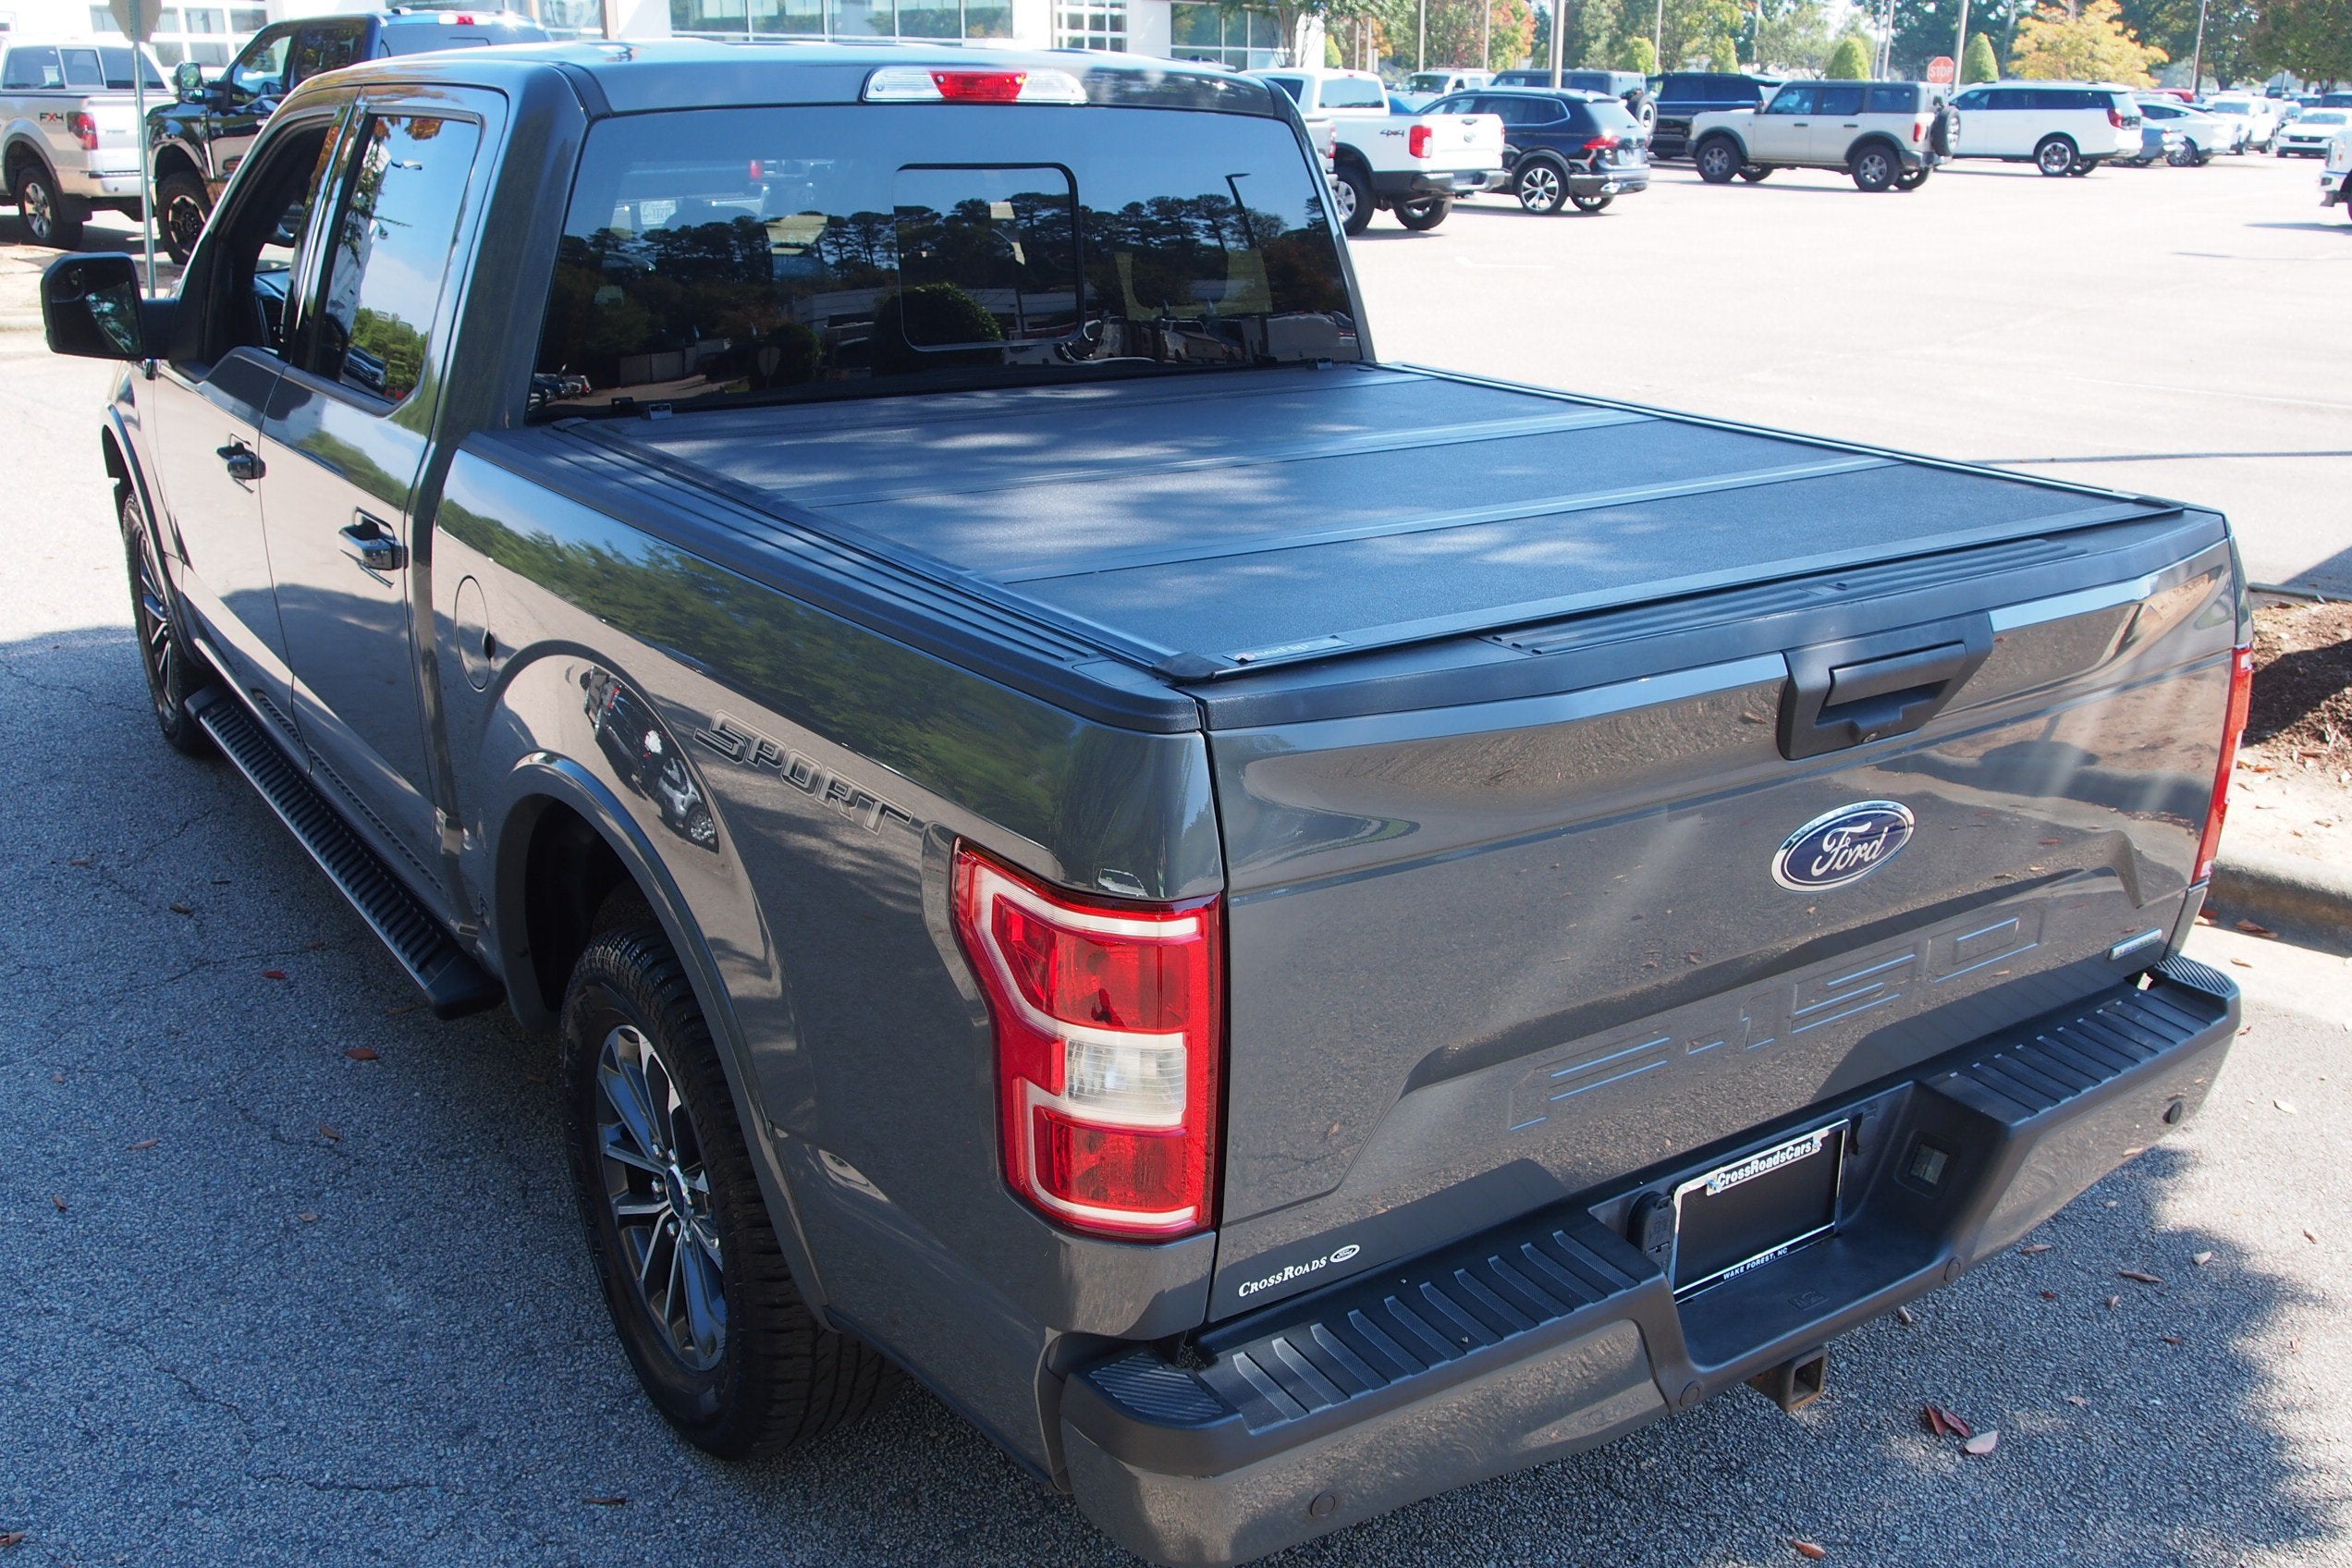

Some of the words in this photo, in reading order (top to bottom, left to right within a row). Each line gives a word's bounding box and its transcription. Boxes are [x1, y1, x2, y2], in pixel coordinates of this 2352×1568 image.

[1929, 66, 1954, 78] STOP
[40, 112, 64, 121] FX4
[693, 709, 914, 836] SPORT
[1810, 821, 1890, 877] Ford
[1508, 900, 2045, 1132] F-150
[1717, 1140, 1812, 1188] CrossRoadsCars
[1722, 1266, 1745, 1280] WAKE
[1746, 1253, 1776, 1270] FOREST,
[1777, 1247, 1788, 1256] NC
